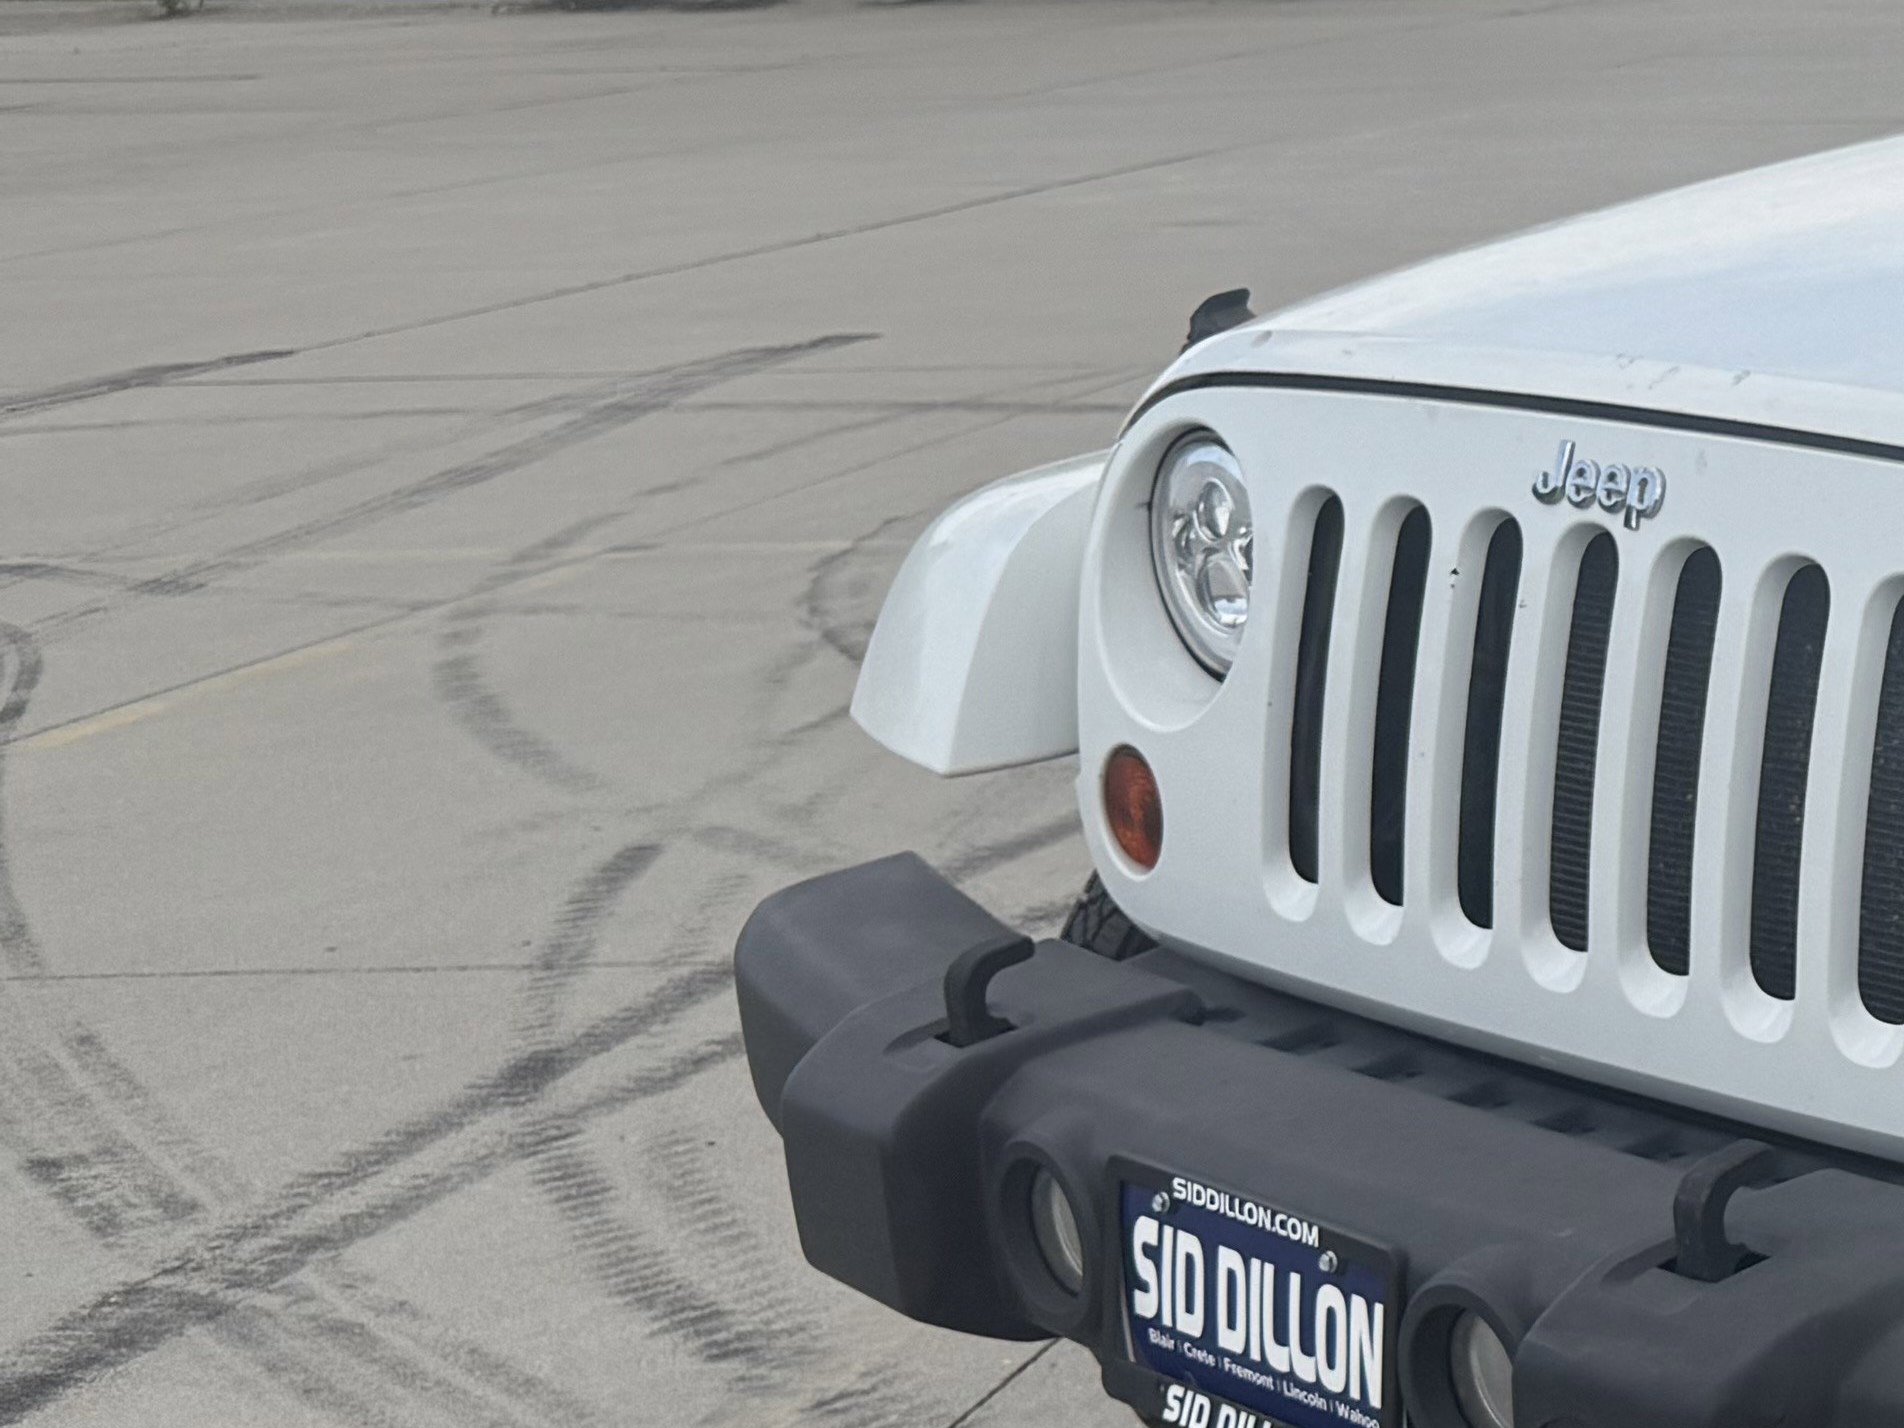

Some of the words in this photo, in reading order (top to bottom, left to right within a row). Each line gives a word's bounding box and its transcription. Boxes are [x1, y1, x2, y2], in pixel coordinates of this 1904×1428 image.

[1532, 439, 1667, 532] Jeep
[1172, 1177, 1320, 1248] SIDDILLON.COM
[1133, 1215, 1205, 1339] SID
[1217, 1244, 1384, 1409] DILLON
[1148, 1327, 1176, 1351] Blair
[1183, 1341, 1216, 1367] Crete
[1223, 1357, 1275, 1390] Fremont
[1281, 1380, 1328, 1412] Lincoln
